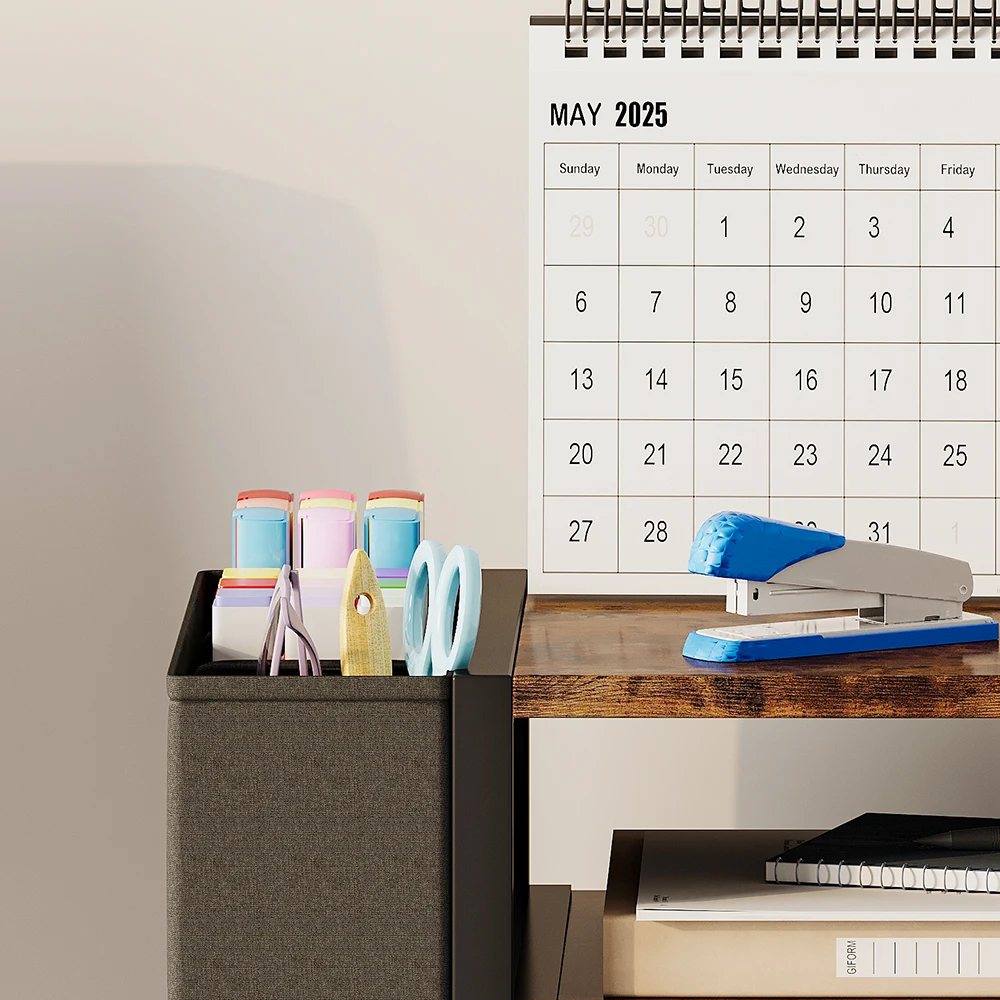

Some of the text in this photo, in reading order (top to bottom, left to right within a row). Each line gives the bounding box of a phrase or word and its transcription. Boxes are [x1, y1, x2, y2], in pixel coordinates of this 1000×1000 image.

[550, 100, 668, 128] MAY 2025
[559, 162, 601, 178] Sunday
[636, 162, 680, 178] Monday
[706, 162, 754, 178] Tuesday
[775, 162, 840, 178] Wednesday
[858, 163, 911, 179] Thursday
[940, 163, 976, 179] Friday
[569, 214, 594, 238] 29
[644, 215, 669, 238] 30
[720, 215, 728, 238] 1
[793, 215, 806, 239] 2
[868, 215, 880, 239] 3
[942, 215, 955, 239] 4
[575, 290, 588, 313] 6
[650, 290, 662, 313] 7
[725, 290, 737, 314] 8
[800, 291, 812, 314] 9
[869, 291, 893, 314] 10
[944, 291, 965, 315] 11
[570, 367, 594, 391] 13
[645, 367, 668, 391] 14
[720, 368, 744, 391] 15
[794, 368, 818, 391] 16
[869, 368, 893, 392] 17
[944, 368, 968, 392] 18
[568, 442, 594, 465] 20
[643, 442, 666, 466] 21
[718, 442, 743, 466] 22
[793, 443, 818, 467] 23
[867, 443, 893, 467] 24
[942, 443, 968, 467] 25
[568, 519, 594, 543] 27
[643, 520, 668, 543] 28
[868, 520, 890, 544] 31
[949, 521, 960, 545] 1
[846, 940, 857, 975] GIFORM
